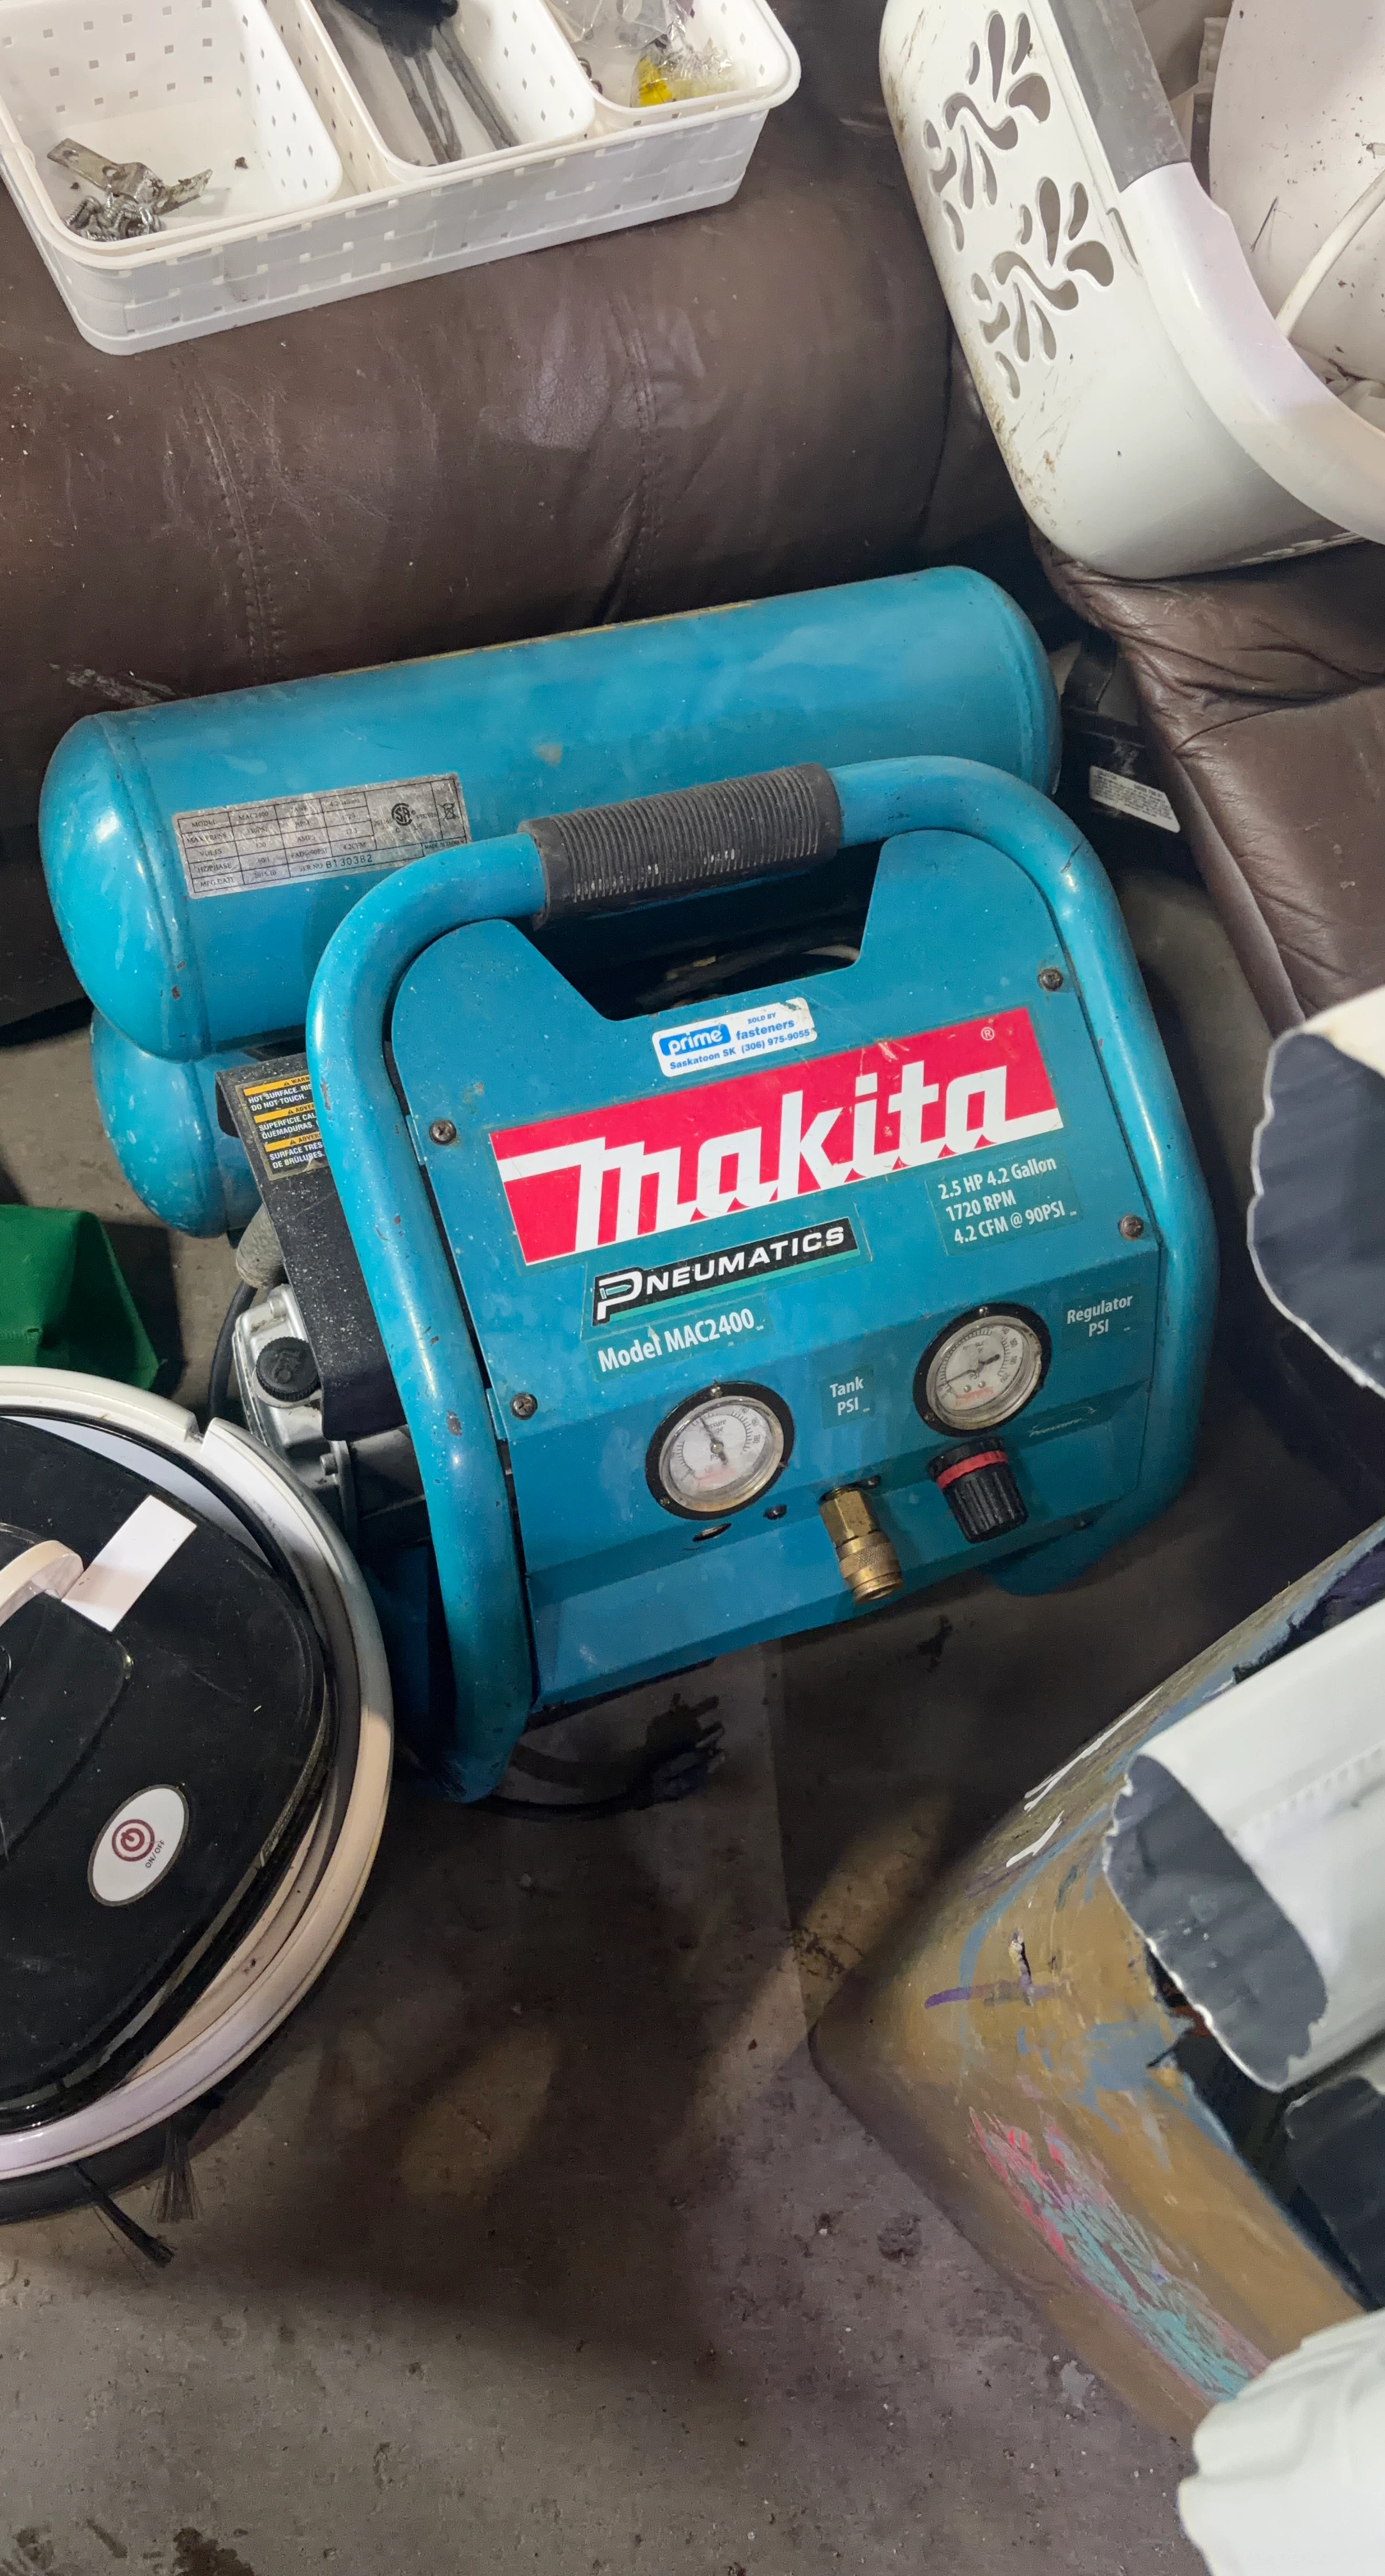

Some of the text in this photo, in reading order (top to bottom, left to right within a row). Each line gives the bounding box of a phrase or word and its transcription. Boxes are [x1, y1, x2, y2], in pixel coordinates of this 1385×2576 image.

[326, 854, 373, 869] B130382
[747, 1012, 777, 1025] SOLD BY
[668, 1019, 795, 1055] prime fasteners
[670, 1029, 811, 1070] Saskatoon SK (306) 975-9055
[248, 1096, 263, 1105] HOT
[251, 1093, 307, 1112] DO NOT TOUCH.
[262, 1121, 315, 1139] QUEMADURAS.
[269, 1147, 303, 1161] SURFACE
[272, 1160, 284, 1169] DE
[496, 1061, 1064, 1253] makita
[937, 1157, 1057, 1200] 2.5 HP 4.2 Gallon
[945, 1189, 1017, 1221] 1720 RPM
[954, 1200, 1066, 1244] 4.2 CFM @ 90PSI
[596, 1225, 845, 1321] PNEUMATICS
[1067, 1295, 1133, 1324] Regulator
[597, 1308, 755, 1373] Model MAC2400
[1089, 1319, 1109, 1337] PSI
[829, 1376, 864, 1398] Tank
[838, 1397, 859, 1416] PSI
[144, 1839, 166, 1869] ON/OFF
